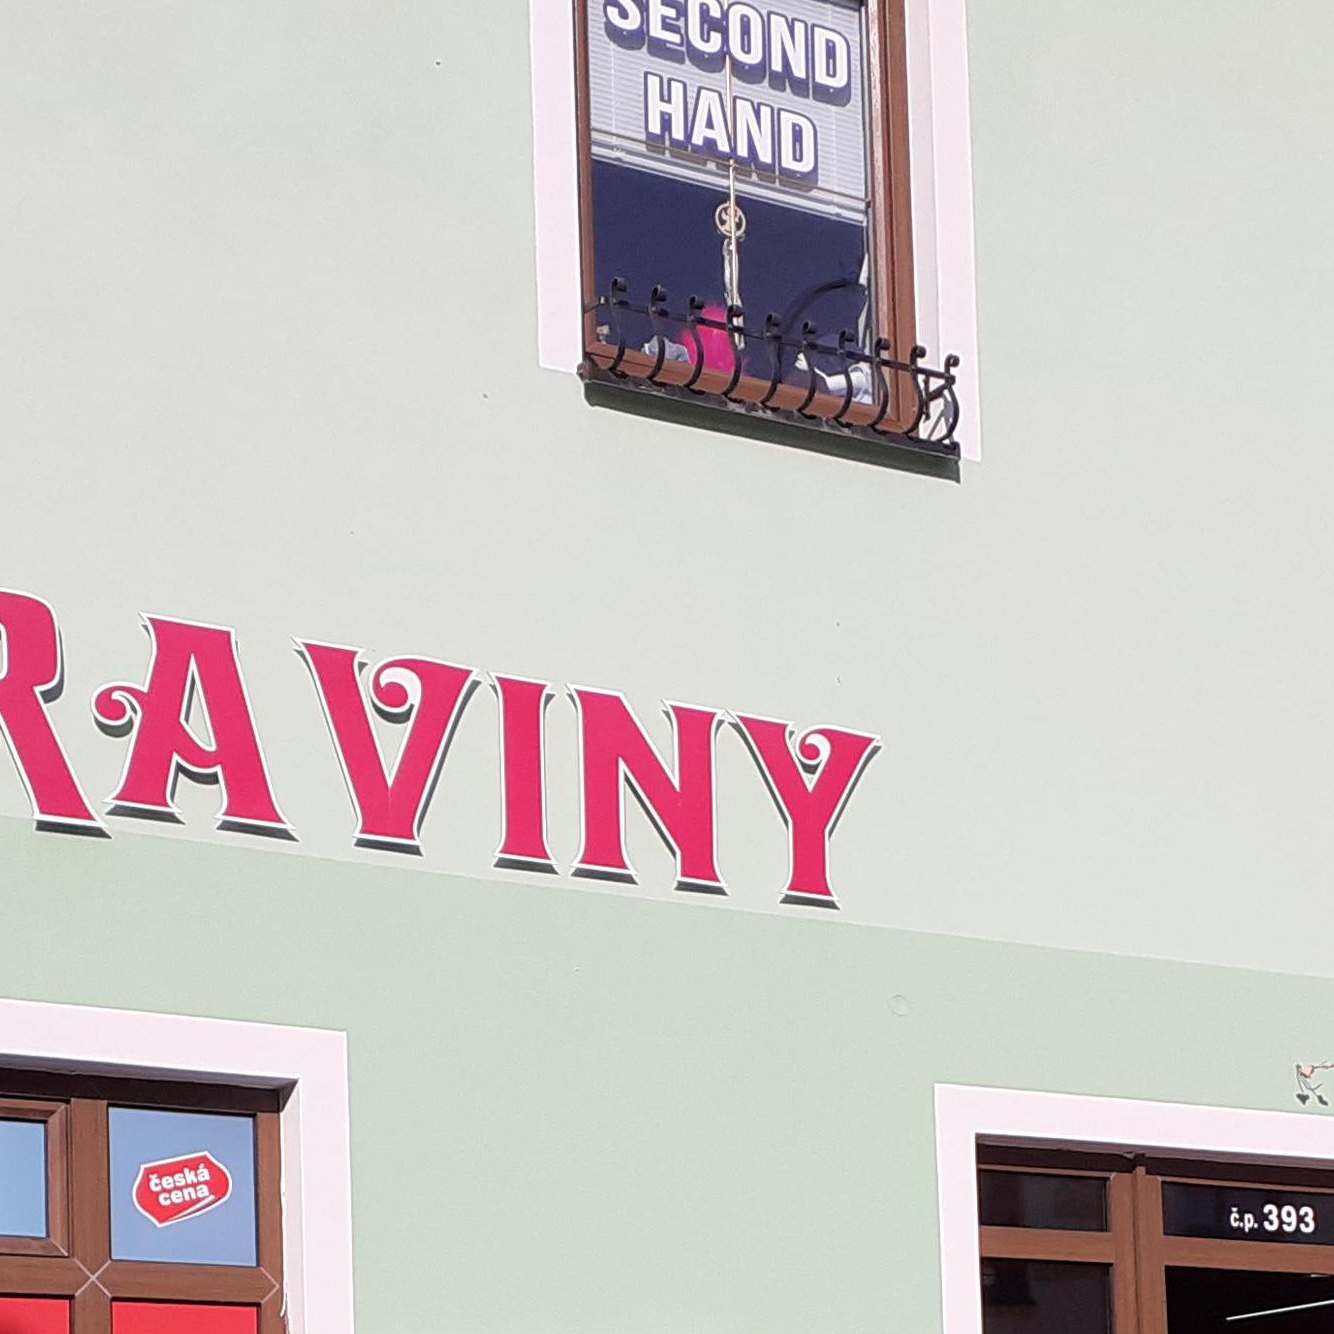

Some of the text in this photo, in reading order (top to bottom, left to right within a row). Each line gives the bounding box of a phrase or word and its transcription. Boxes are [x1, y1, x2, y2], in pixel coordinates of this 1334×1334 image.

[604, 0, 851, 100] SECOND
[644, 71, 818, 180] HAND
[148, 1163, 211, 1192] česká
[158, 1184, 210, 1206] cena
[1230, 1204, 1315, 1233] č.p. 393
